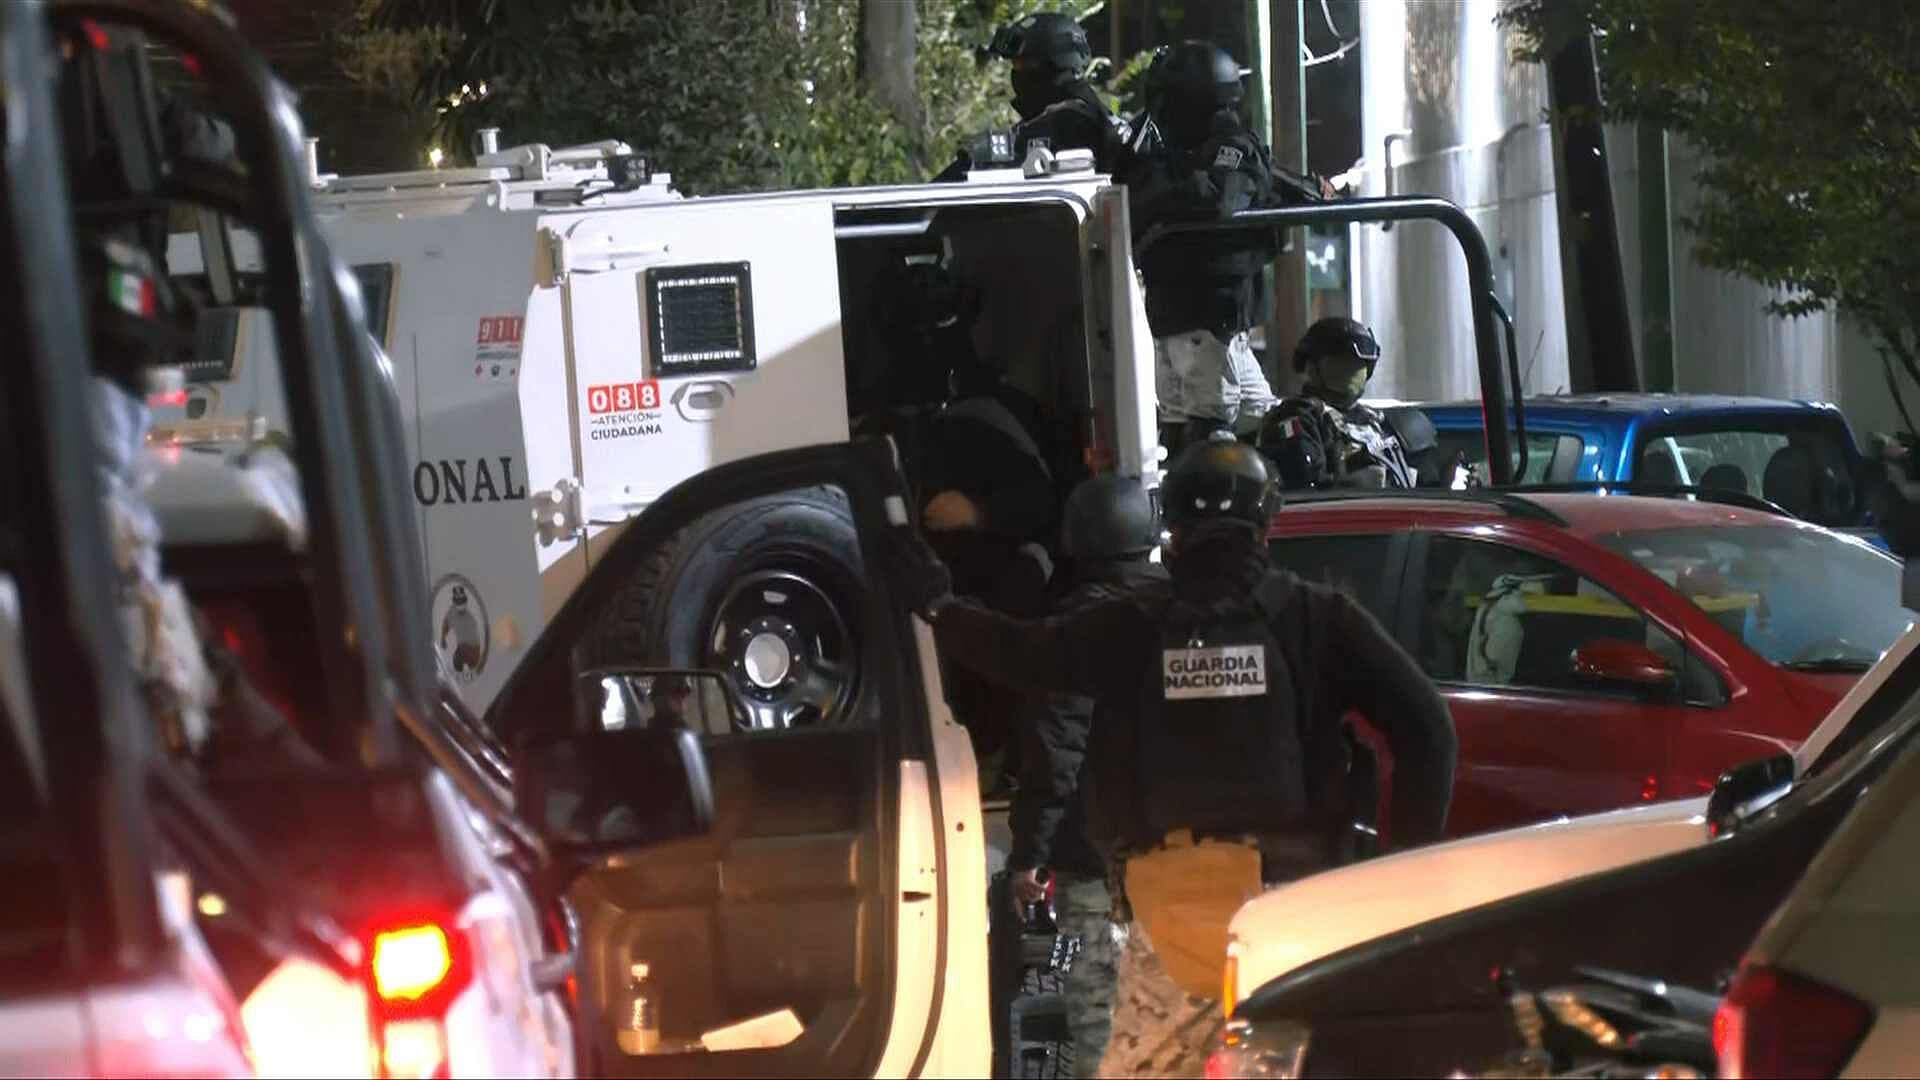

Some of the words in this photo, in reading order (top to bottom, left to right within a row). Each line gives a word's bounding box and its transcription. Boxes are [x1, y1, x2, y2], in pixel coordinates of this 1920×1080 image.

[481, 318, 518, 339] 911
[592, 385, 656, 411] 088
[591, 424, 662, 441] CIUDADANA
[414, 456, 525, 506] ONAL
[1169, 655, 1258, 674] GUARDIA
[1165, 671, 1264, 688] NACIONAL
